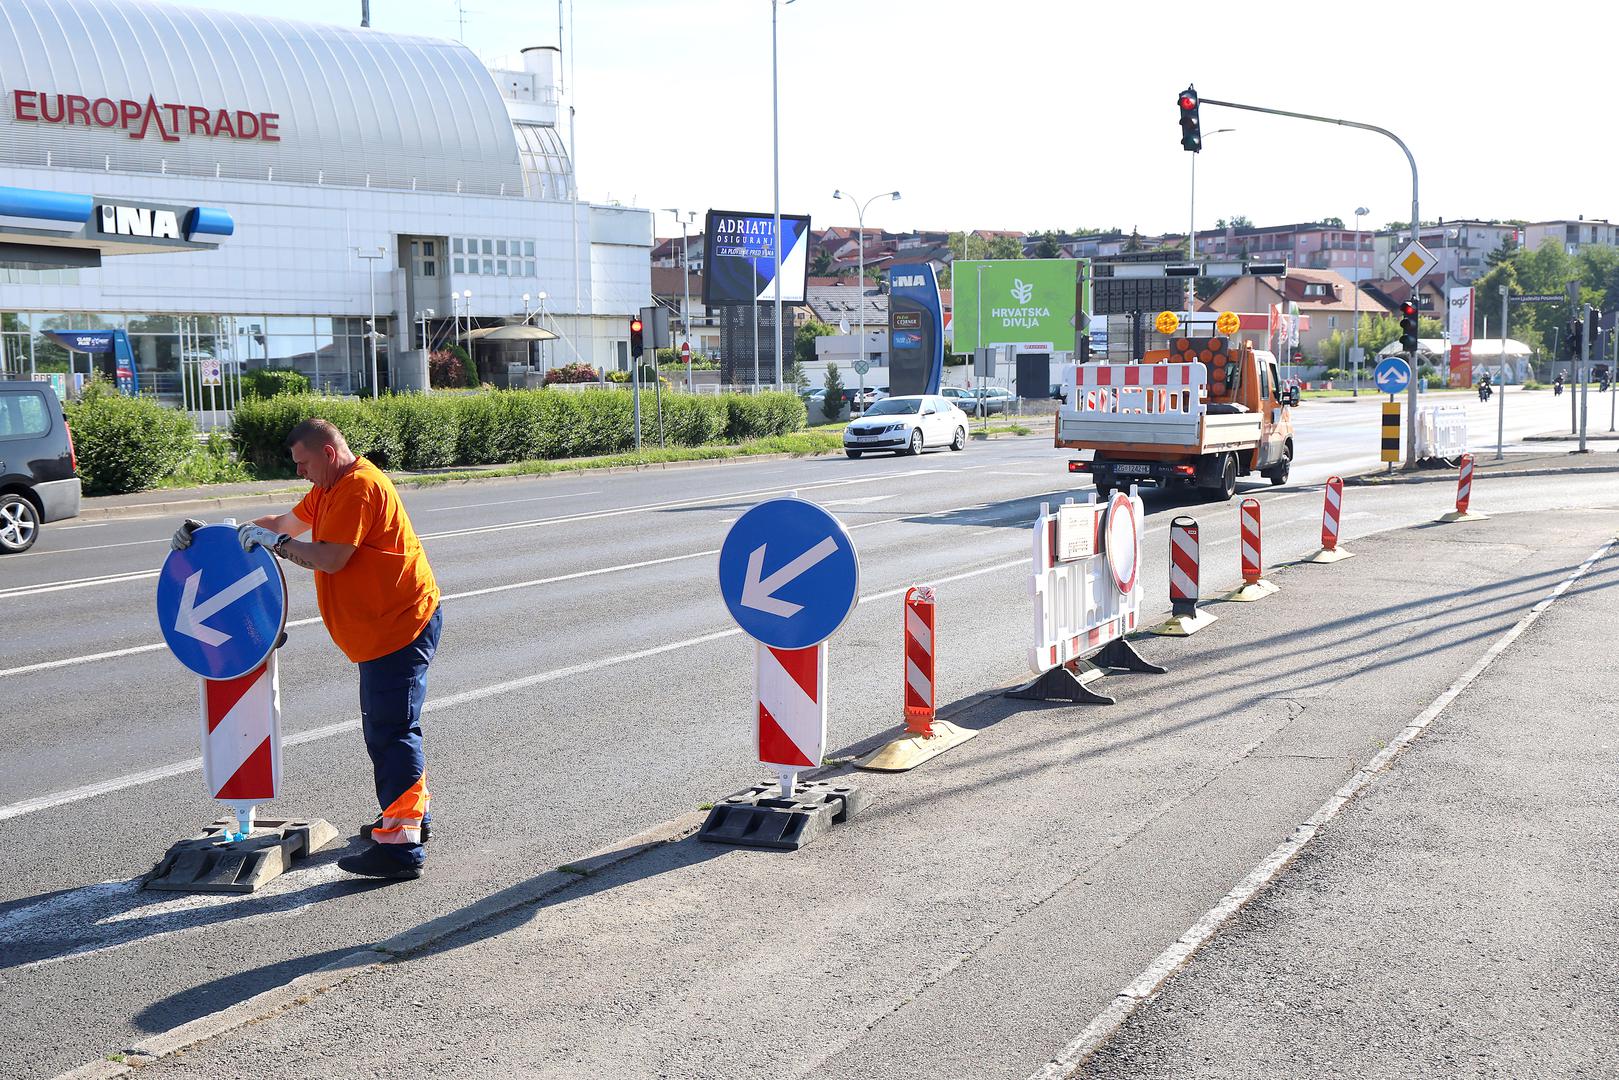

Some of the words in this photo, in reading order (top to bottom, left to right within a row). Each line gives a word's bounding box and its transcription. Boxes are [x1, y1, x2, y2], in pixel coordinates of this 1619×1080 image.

[14, 89, 280, 142] EUROPATRADE
[718, 219, 775, 235] ADRIATI
[717, 235, 773, 245] OSIGURANJ
[991, 307, 1050, 318] HRVATSKA
[1002, 318, 1040, 328] DIVLJA
